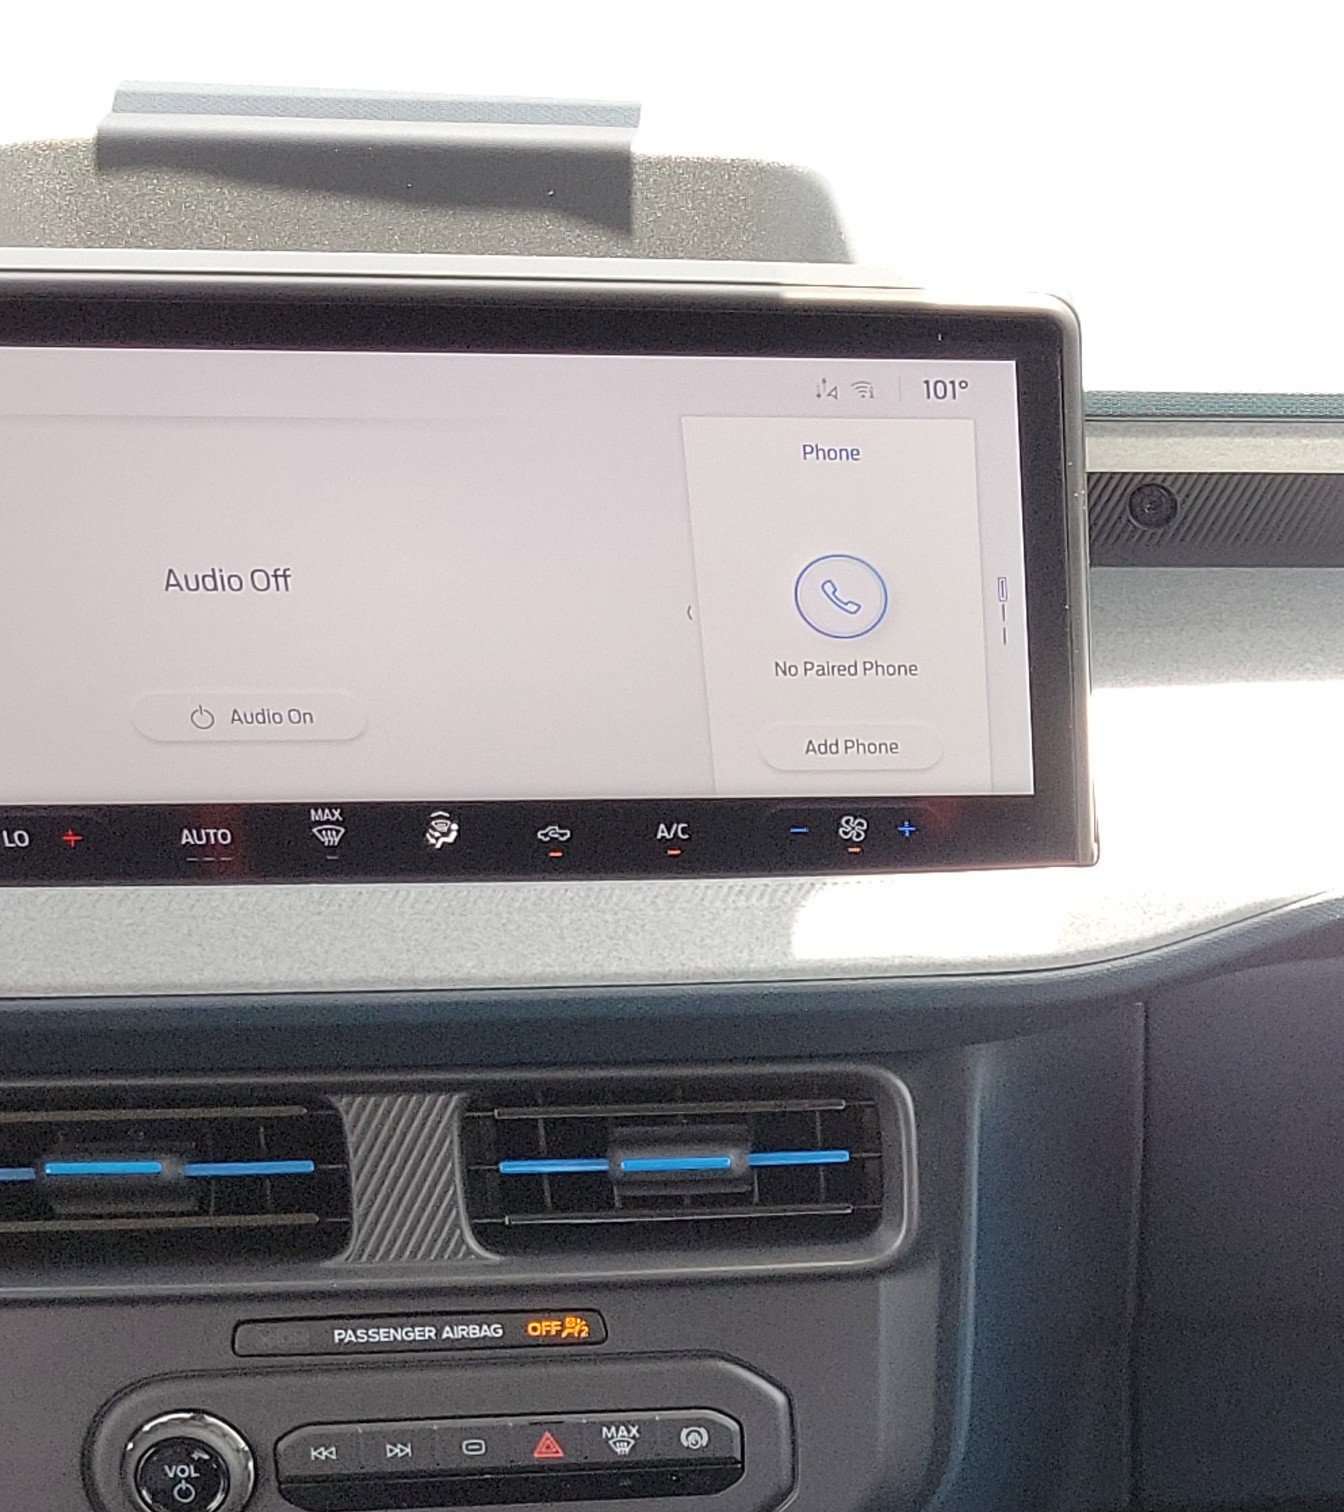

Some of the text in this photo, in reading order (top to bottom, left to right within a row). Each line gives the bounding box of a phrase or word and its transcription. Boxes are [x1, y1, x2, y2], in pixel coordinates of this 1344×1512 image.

[802, 443, 861, 461] Phone
[164, 567, 292, 592] Audio Off
[774, 659, 919, 677] No Paired Phone
[230, 708, 314, 725] Audio On
[805, 738, 899, 755] Add Phone
[310, 808, 344, 822] MAX
[2, 829, 31, 848] LO
[181, 828, 233, 846] AUTO
[656, 822, 691, 840] A/C
[333, 1319, 563, 1344] PASSENGER AIRBAG OFF
[601, 1425, 641, 1439] MAX
[163, 1463, 201, 1479] VOL
